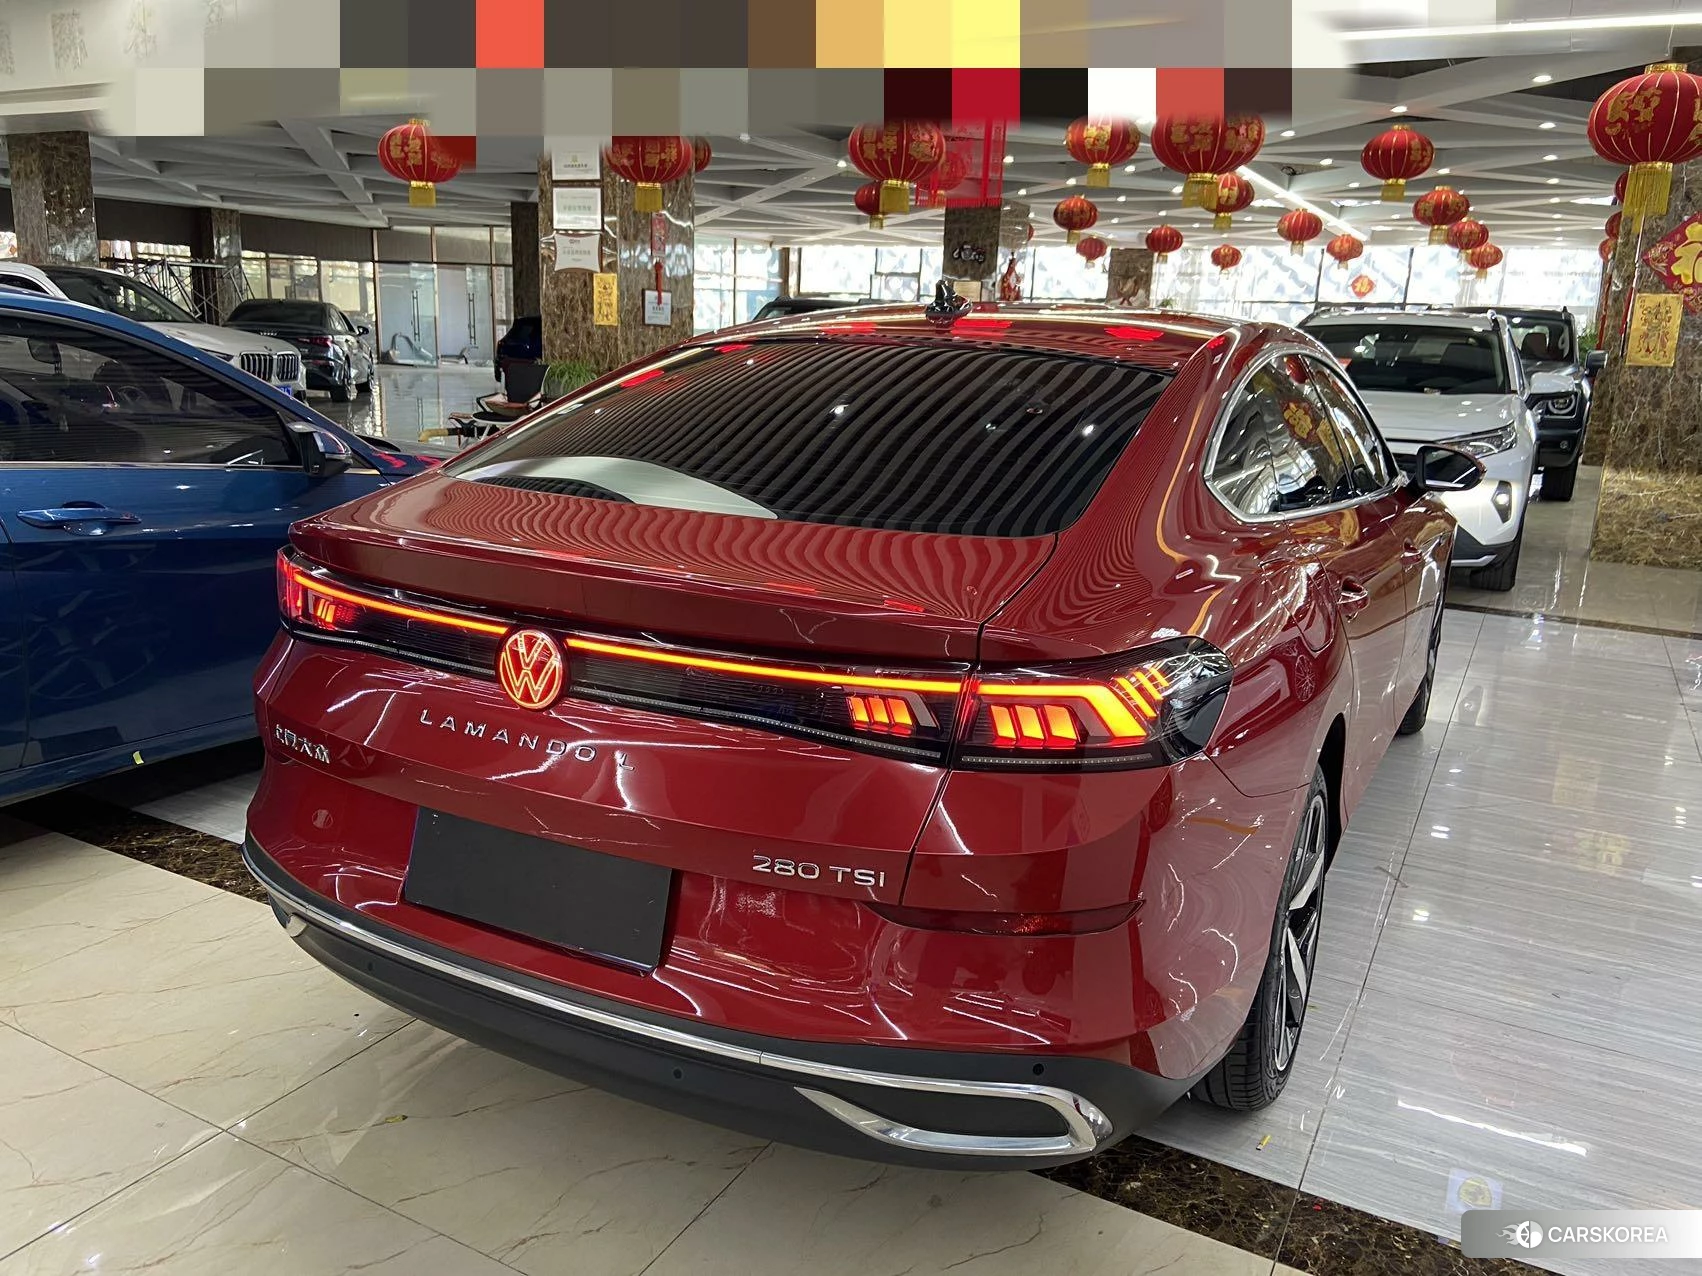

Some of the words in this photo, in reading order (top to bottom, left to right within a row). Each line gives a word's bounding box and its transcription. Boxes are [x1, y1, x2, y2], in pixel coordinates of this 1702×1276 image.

[420, 709, 596, 762] LAMANDO
[616, 752, 635, 771] L
[752, 854, 820, 880] 280
[829, 865, 885, 888] TSI
